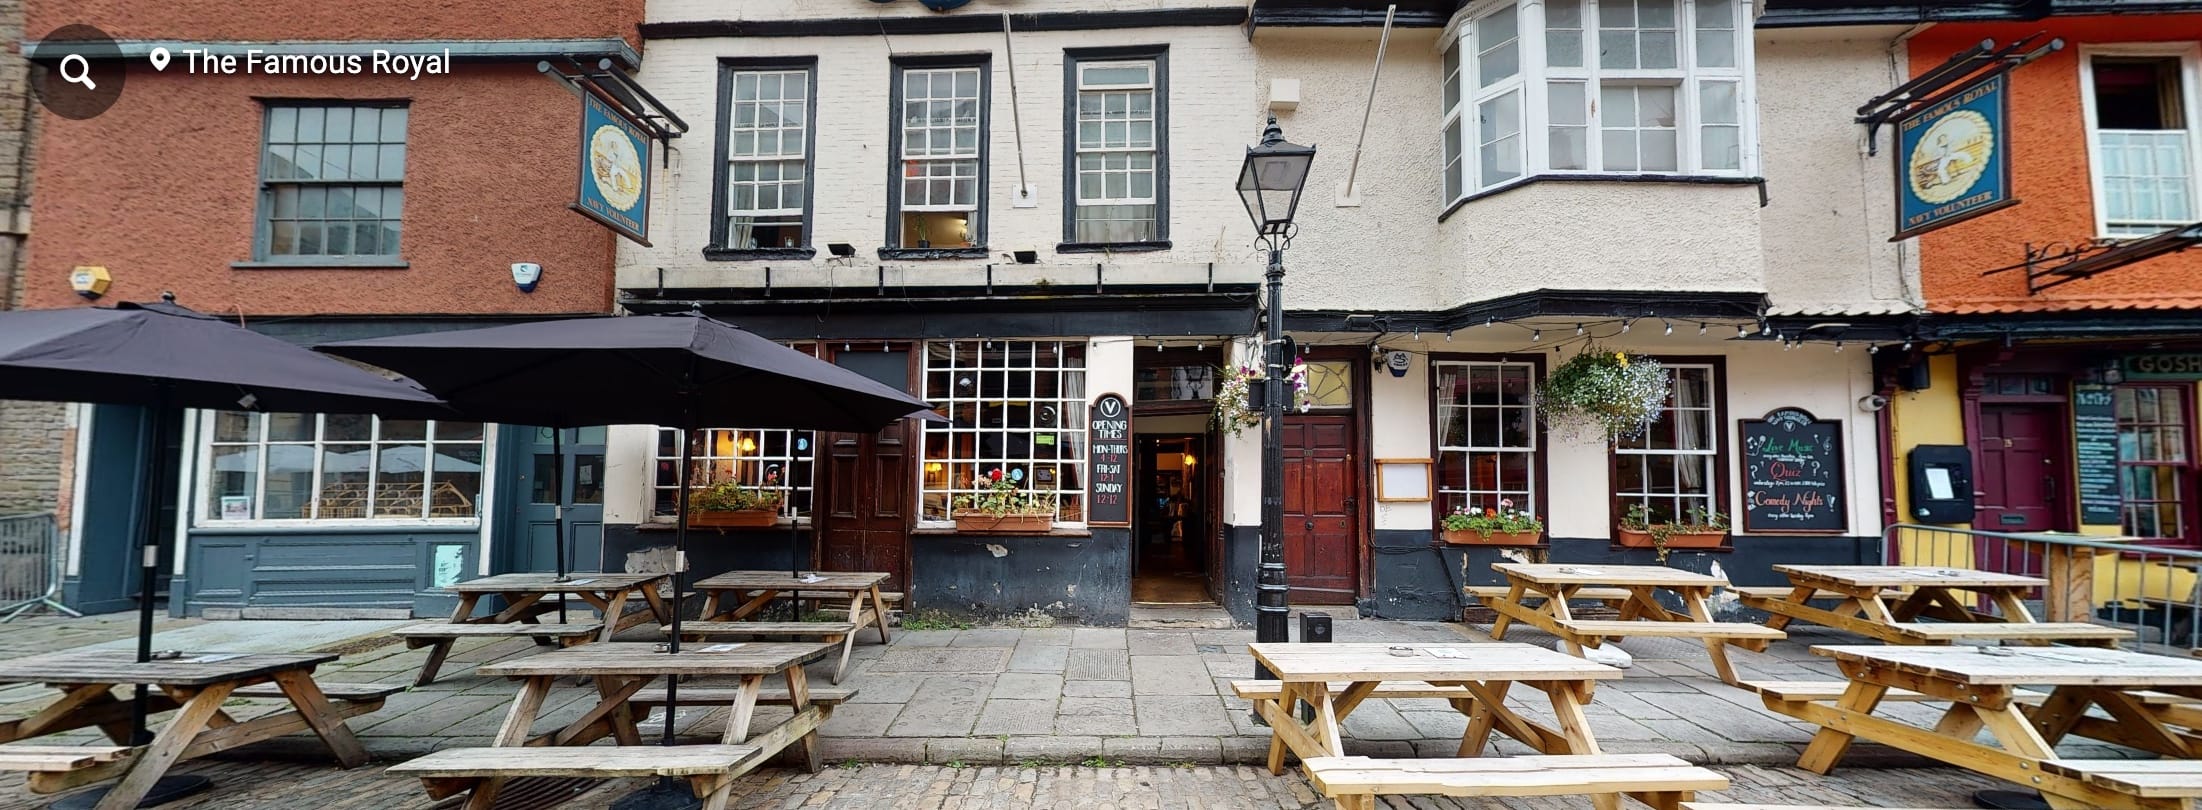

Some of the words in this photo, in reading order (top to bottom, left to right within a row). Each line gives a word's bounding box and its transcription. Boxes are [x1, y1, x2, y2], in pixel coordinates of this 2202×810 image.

[1902, 119, 1921, 131] THE
[1923, 101, 1960, 122] FAMOUS
[1963, 82, 1997, 104] ROYAL
[589, 99, 602, 113] THE
[604, 108, 627, 131] FAMOUS
[629, 126, 648, 145] ROYAL
[1934, 192, 1992, 216] VOLUNTEER
[606, 206, 640, 231] VOLUNTEER
[2139, 355, 2202, 373] GOSH
[1092, 420, 1127, 431] OPENING
[1099, 429, 1122, 439] TIMES
[1770, 461, 1802, 481] Quiz
[1095, 483, 1123, 493] SUNDAY
[1755, 491, 1791, 513] Comedy
[1793, 491, 1824, 513] Nights
